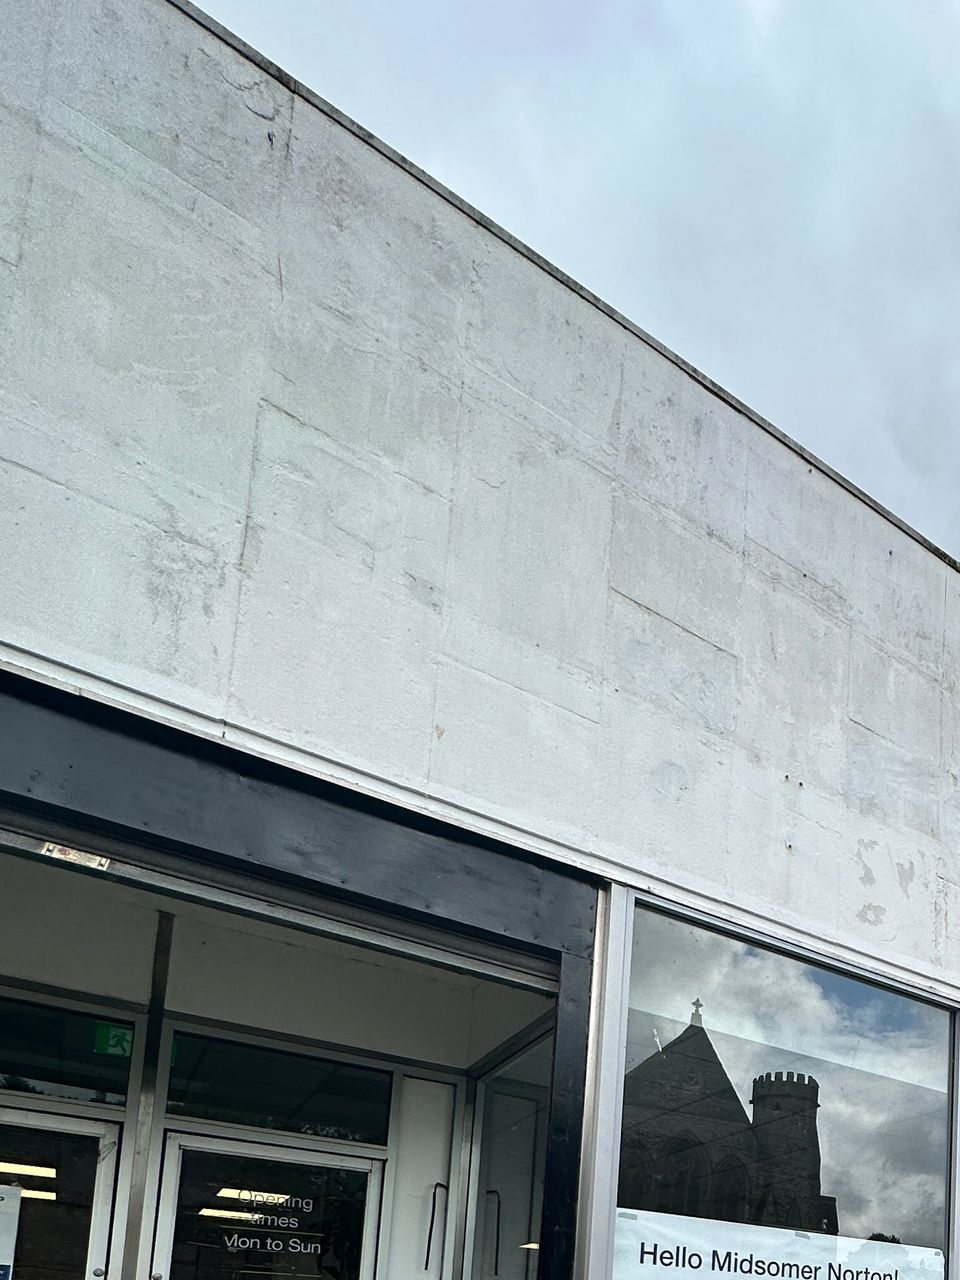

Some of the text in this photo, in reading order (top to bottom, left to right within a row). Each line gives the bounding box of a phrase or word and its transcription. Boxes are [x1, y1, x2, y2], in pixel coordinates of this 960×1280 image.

[238, 1189, 313, 1212] Opening
[251, 1211, 299, 1228] times
[266, 1237, 283, 1251] to
[288, 1238, 321, 1254] Sun
[639, 1242, 702, 1270] Hello
[711, 1250, 821, 1280] Midsomer
